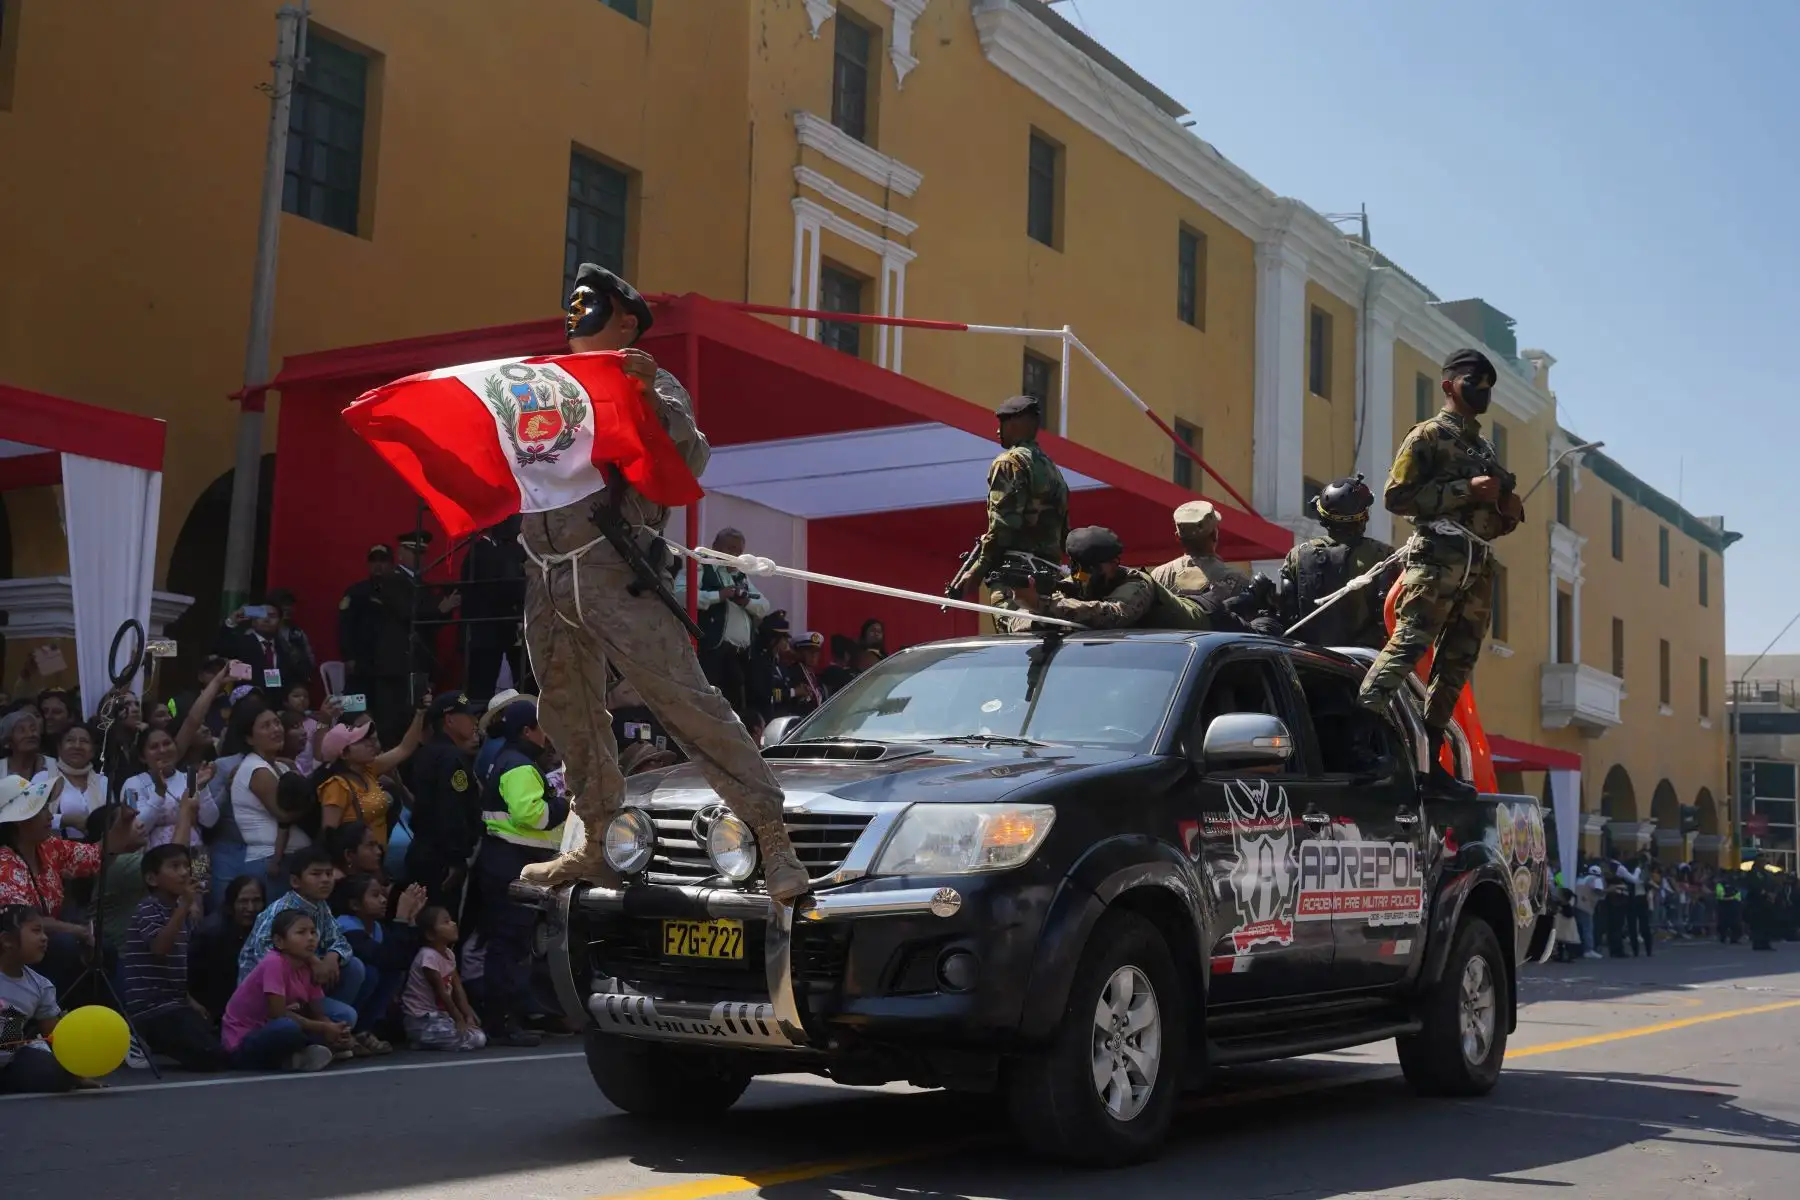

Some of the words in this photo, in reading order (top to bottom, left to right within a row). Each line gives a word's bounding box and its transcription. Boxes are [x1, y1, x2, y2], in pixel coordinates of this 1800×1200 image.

[1300, 845, 1423, 889] APREPOL
[1344, 895, 1360, 910] PRE
[1363, 895, 1389, 909] MILITAR
[665, 922, 742, 958] F7G-727
[654, 1020, 728, 1037] HILUX
